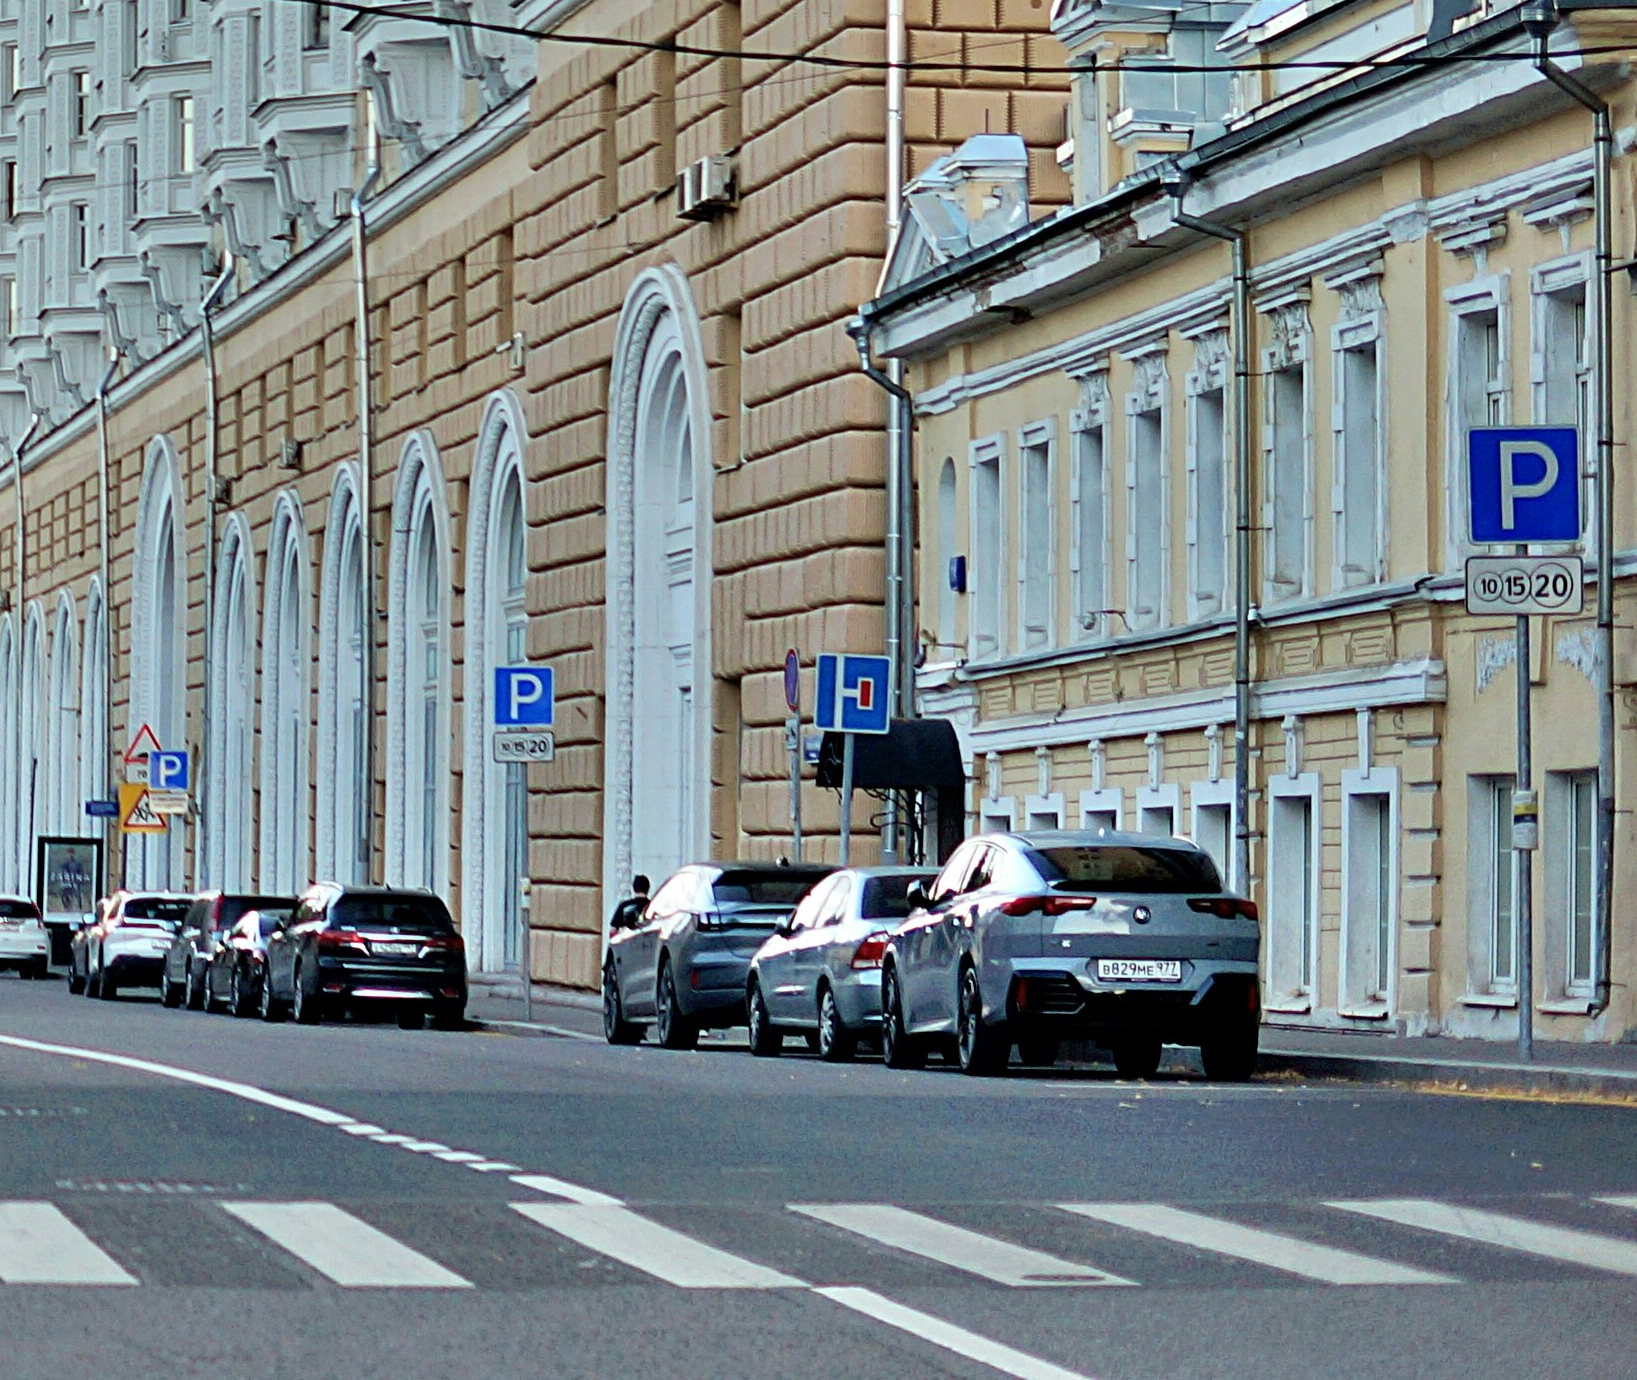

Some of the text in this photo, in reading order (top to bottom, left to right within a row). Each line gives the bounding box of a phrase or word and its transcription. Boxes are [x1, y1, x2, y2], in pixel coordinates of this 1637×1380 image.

[1500, 441, 1559, 530] P
[1481, 574, 1568, 598] 10 15 20
[510, 673, 543, 720] P
[529, 740, 547, 753] 20
[159, 755, 182, 786] P
[1157, 962, 1177, 973] 977
